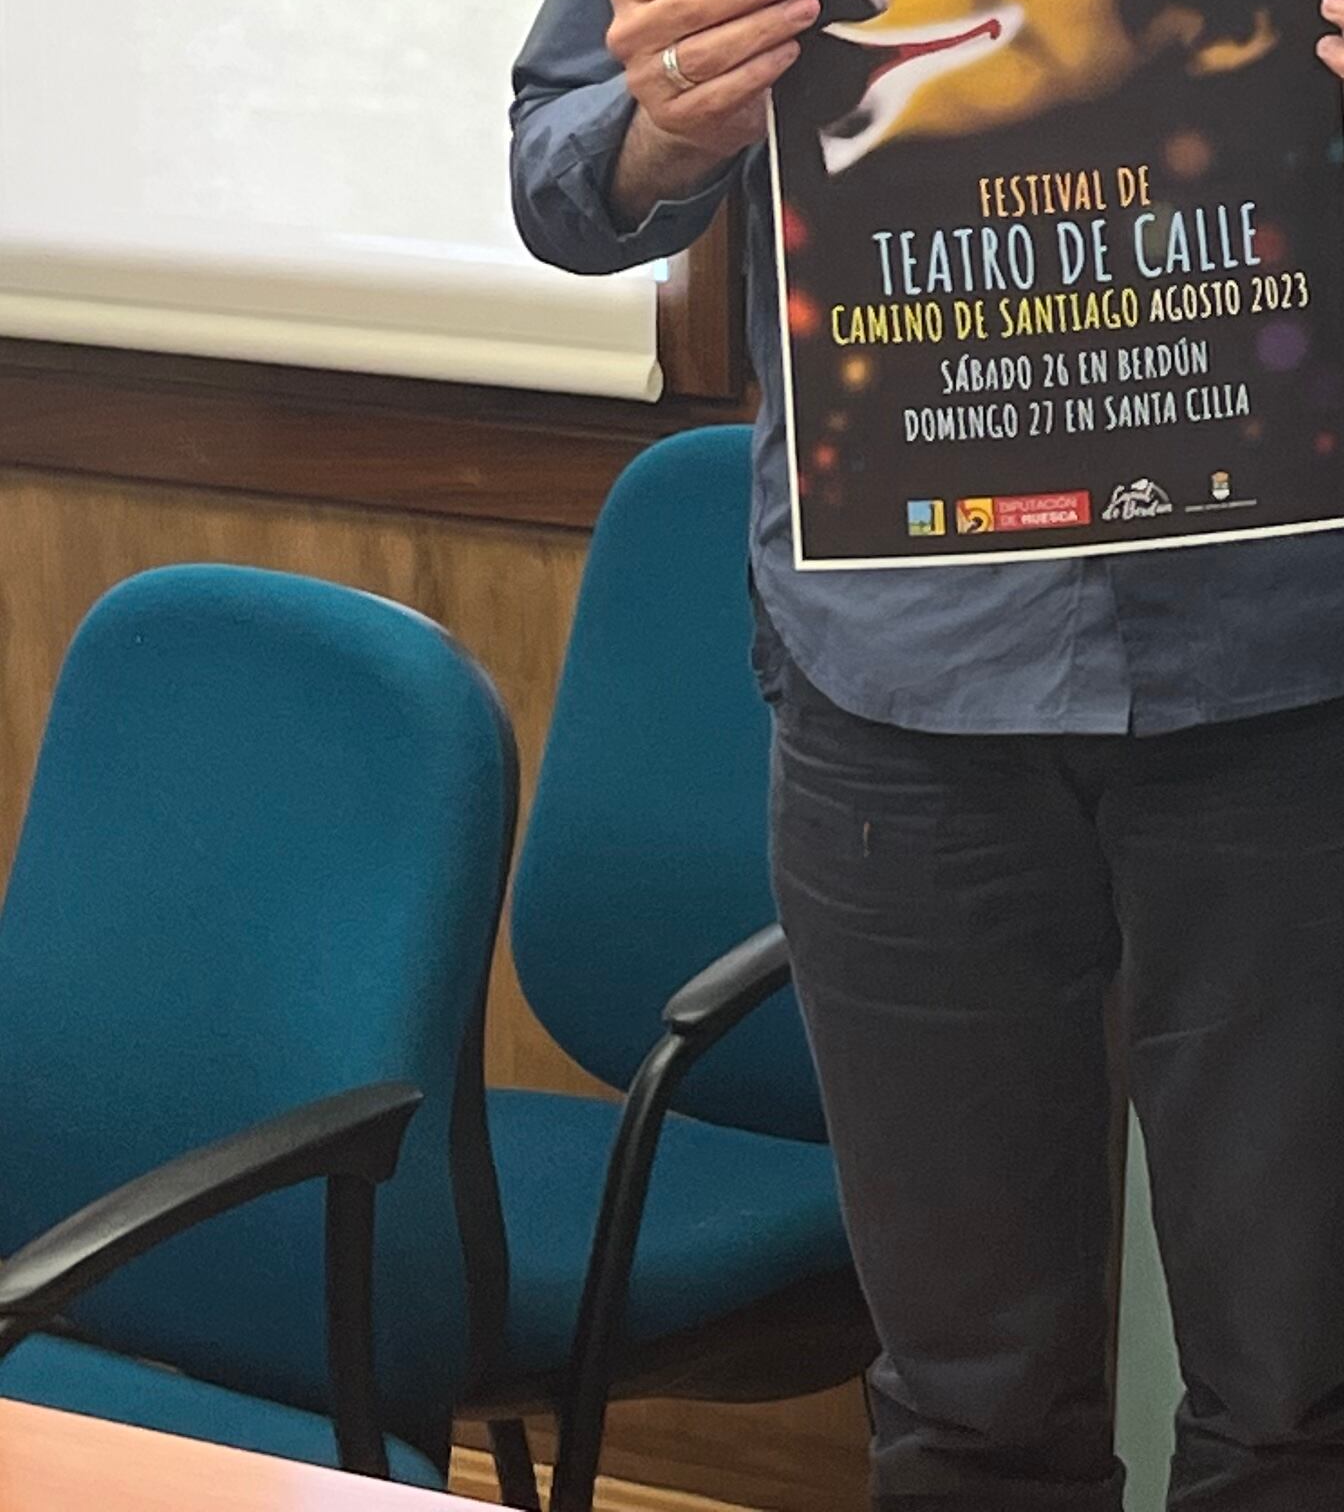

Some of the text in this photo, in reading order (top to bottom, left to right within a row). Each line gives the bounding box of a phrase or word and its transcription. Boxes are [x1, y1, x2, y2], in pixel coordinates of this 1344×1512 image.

[980, 165, 1151, 219] FESTIVAL DE
[872, 202, 1261, 296] TEATRO DE CALLE
[831, 271, 1310, 344] CAMINO DE SANTIAGO AGOSTO 2023
[941, 339, 1209, 394] SÁBADO 26 EN BERDÚN
[904, 384, 1251, 442] DOMINGO 27 EN SANTA CILIA
